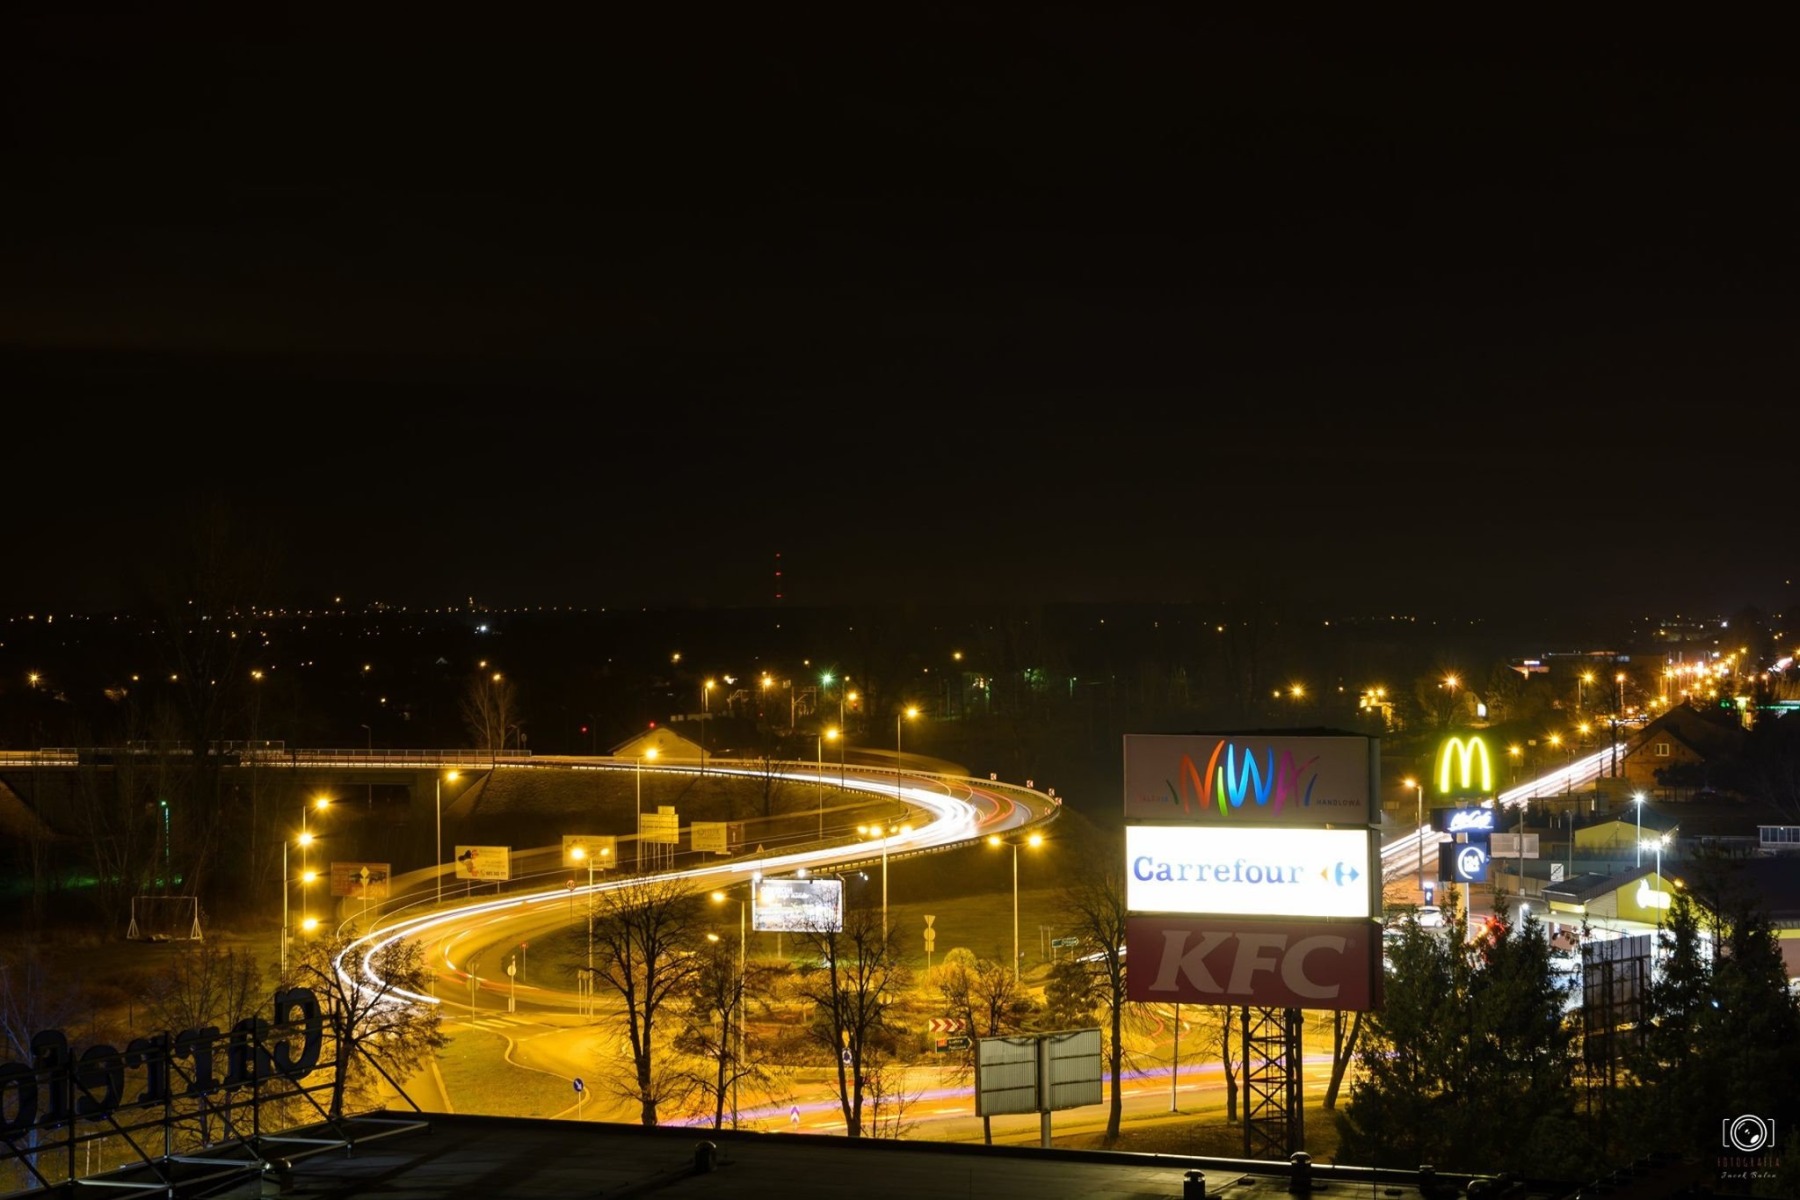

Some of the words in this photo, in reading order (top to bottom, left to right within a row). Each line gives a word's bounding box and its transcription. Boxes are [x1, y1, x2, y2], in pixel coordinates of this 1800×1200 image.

[1316, 799, 1361, 807] HANDLOWA
[1133, 856, 1304, 885] Carrefour
[1149, 930, 1347, 999] KFC
